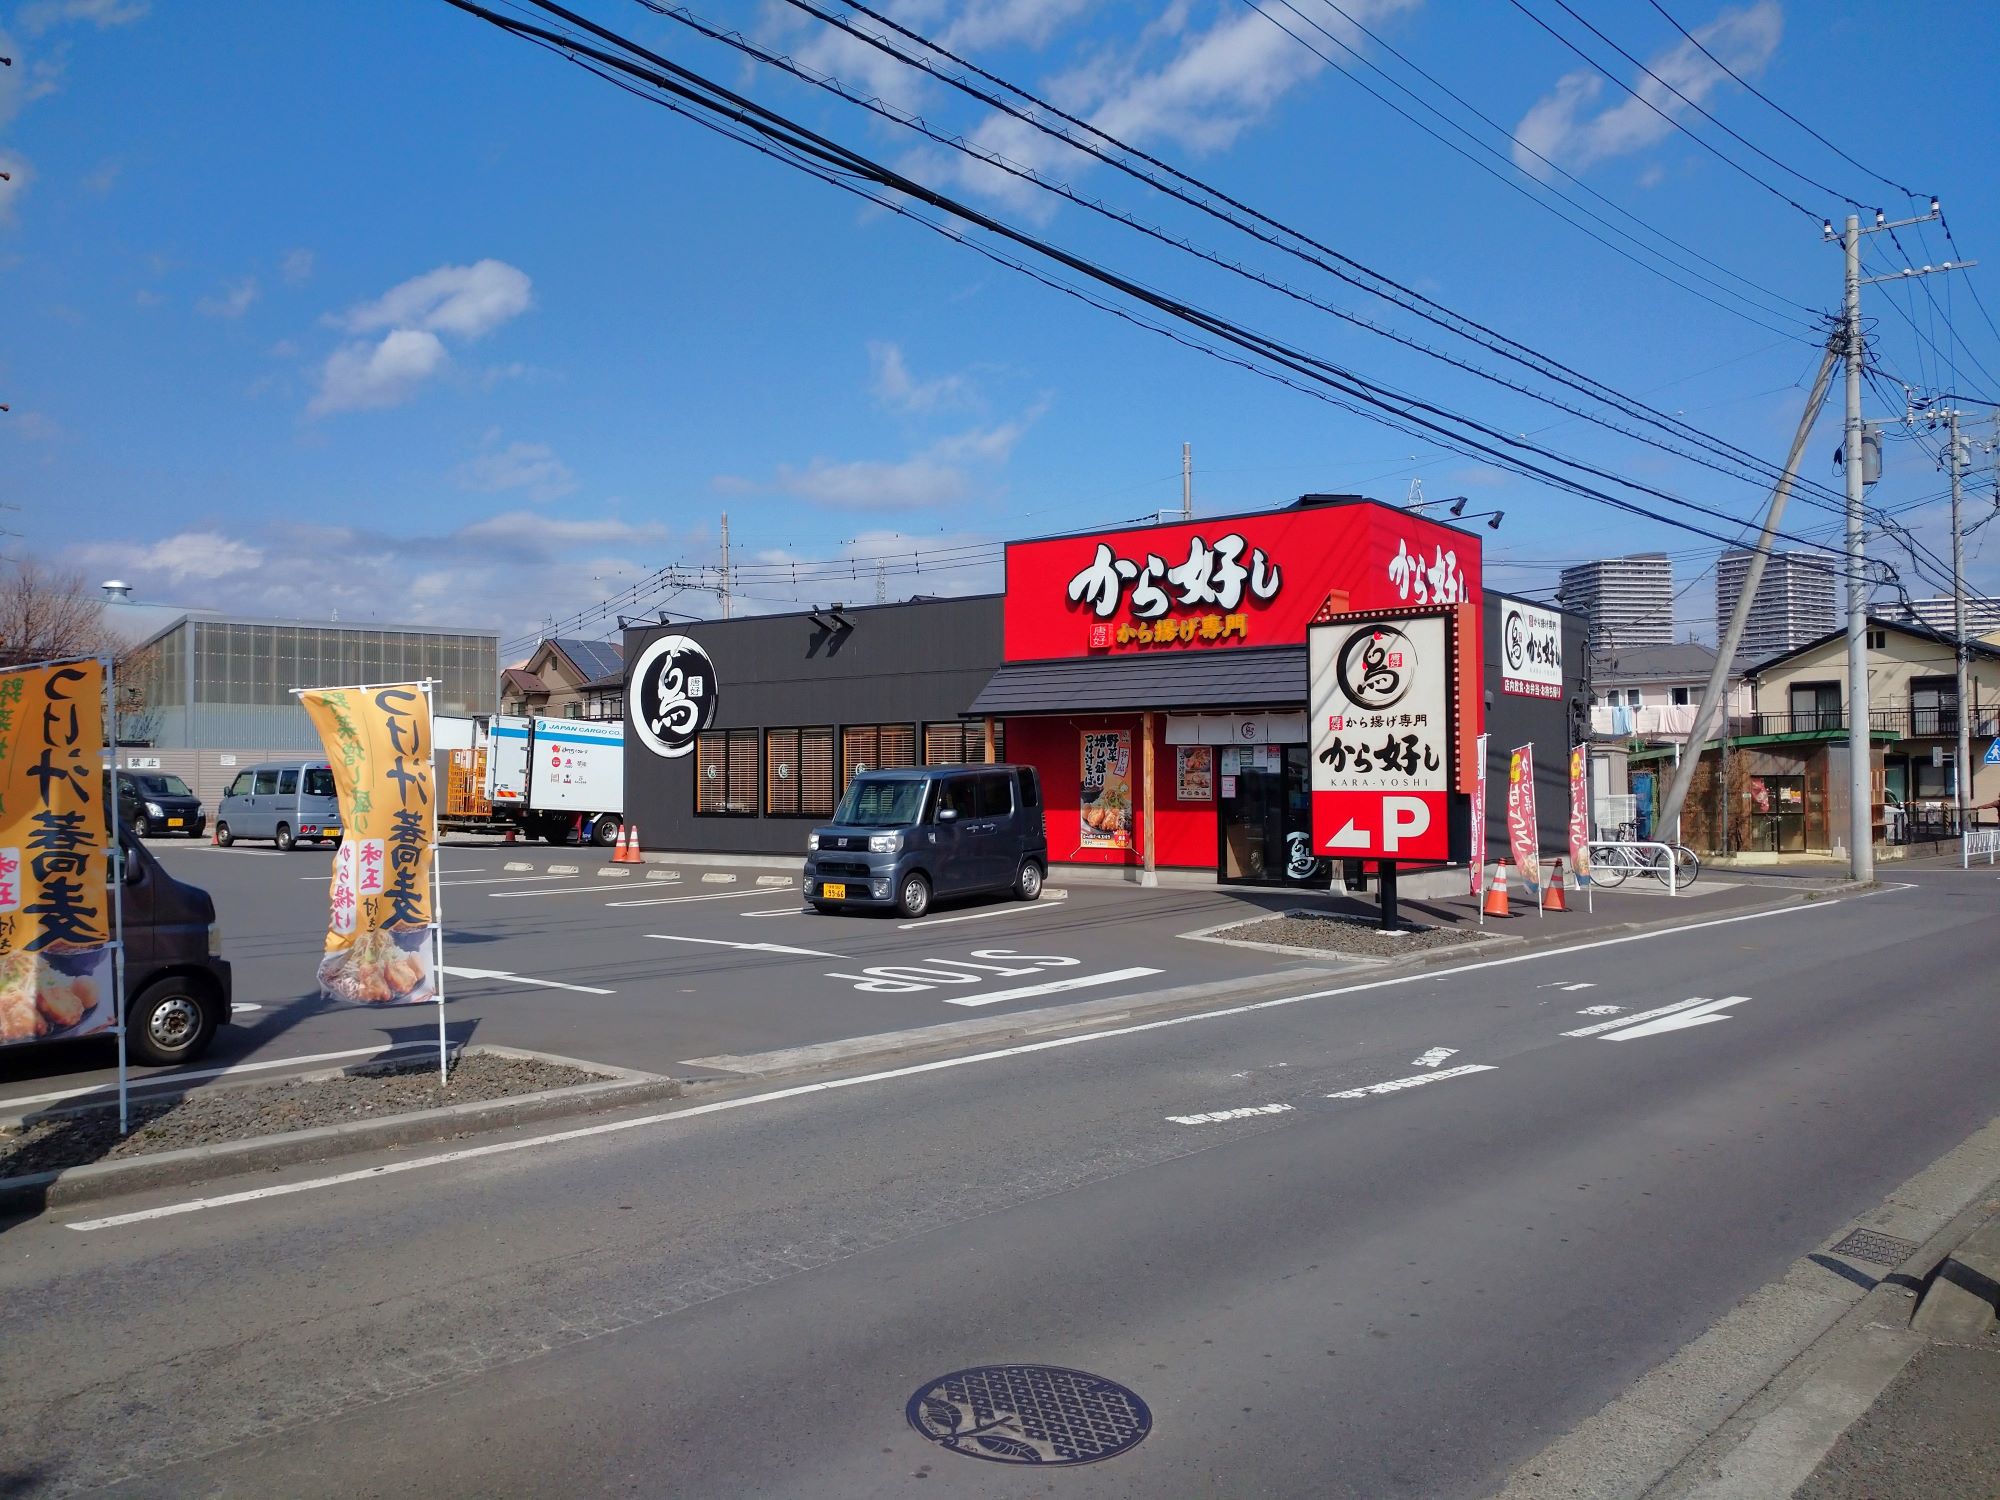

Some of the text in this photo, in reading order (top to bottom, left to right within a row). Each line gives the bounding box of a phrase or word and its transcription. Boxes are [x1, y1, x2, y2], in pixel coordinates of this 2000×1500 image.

[1068, 533, 1281, 617] から好し
[1389, 538, 1469, 604] から好し
[1117, 613, 1248, 644] から揚げ専門
[1526, 631, 1561, 669] から好し
[549, 724, 577, 732] JAPAN
[578, 727, 608, 736] CARGO
[1346, 714, 1427, 728] から揚げ専門
[131, 757, 157, 768] 禁止
[1106, 733, 1119, 763] 野菜
[1319, 733, 1440, 777] から好し
[1331, 779, 1428, 787] KARA-YOSHI
[1382, 796, 1431, 852] P
[824, 949, 1081, 993] STOP
